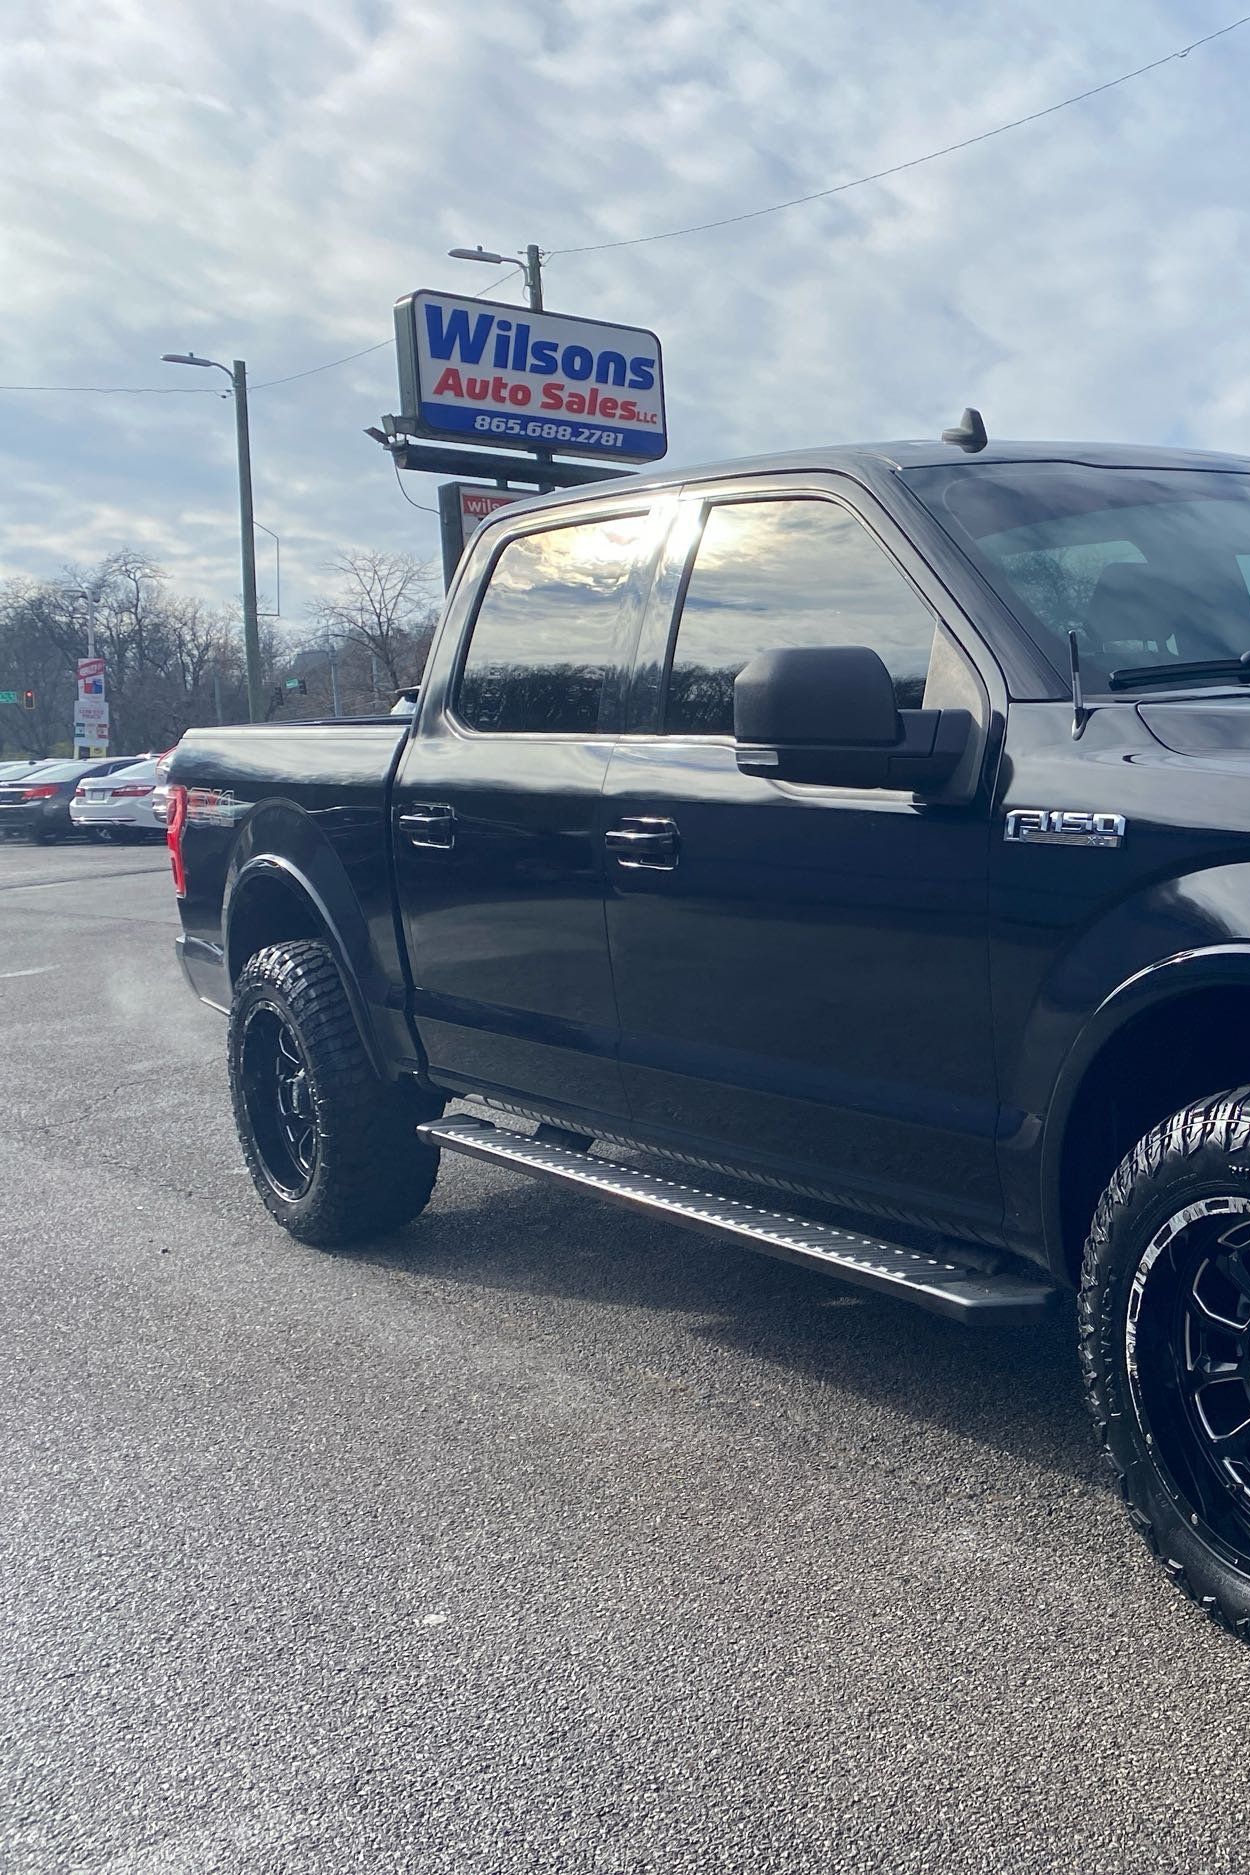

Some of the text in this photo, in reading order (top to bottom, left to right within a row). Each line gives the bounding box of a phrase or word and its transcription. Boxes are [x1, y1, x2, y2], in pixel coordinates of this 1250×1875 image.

[425, 304, 655, 390] Wilsons
[432, 367, 658, 426] Auto Sales LLC
[474, 415, 624, 447] 865.688.2781
